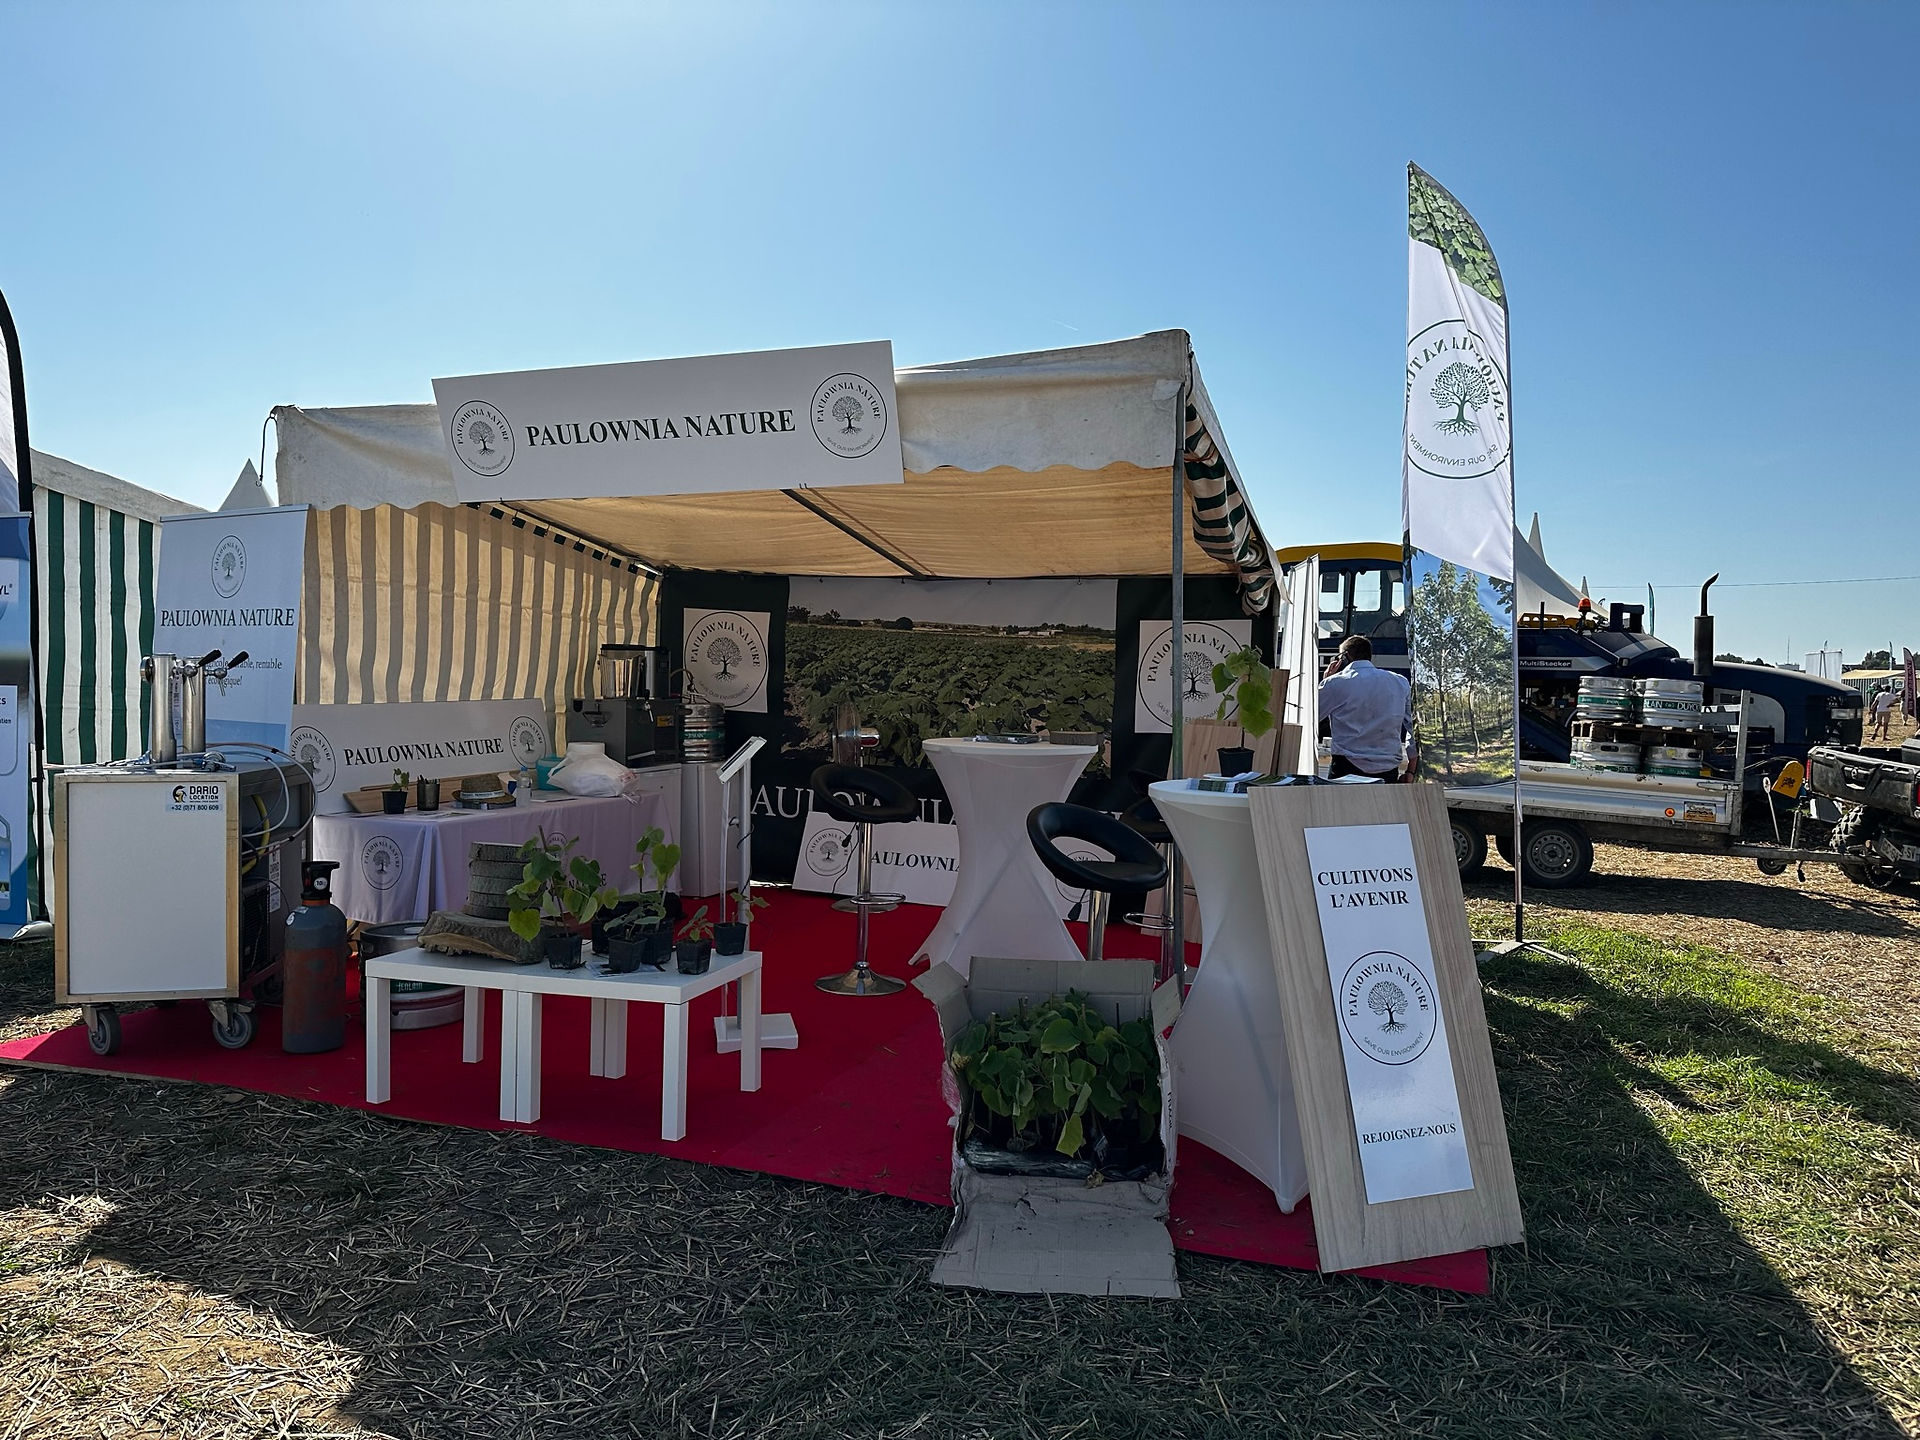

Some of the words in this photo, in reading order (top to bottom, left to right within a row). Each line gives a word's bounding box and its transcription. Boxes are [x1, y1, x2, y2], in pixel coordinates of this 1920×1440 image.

[817, 382, 854, 422] PAULOWNIA
[856, 385, 880, 419] NATURE
[457, 409, 484, 444] PAULOWNIA
[486, 411, 509, 441] NATURE
[526, 416, 680, 447] PAULOWNIA
[684, 409, 796, 438] NATURE
[161, 608, 237, 627] PAULOWNIA
[239, 608, 295, 626] NATURE
[691, 621, 735, 663] PAULOWNIA
[736, 625, 761, 668] NATURE
[1147, 633, 1206, 682] PAULONIA
[291, 733, 312, 760] AULOWNIA
[344, 742, 443, 766] PAULOWNIA
[446, 738, 504, 756] NATURE
[190, 785, 219, 795] DARIO
[871, 850, 960, 873] AULOWNI
[1317, 867, 1414, 886] CULTIVONS
[1330, 890, 1410, 909] L'AVENIR
[1349, 963, 1393, 1016] PAULOWNIA
[1396, 966, 1429, 1011] NATURE
[1363, 1036, 1377, 1050] SAVE
[1377, 1047, 1391, 1056] OUR
[1391, 1031, 1424, 1057] ENVIRONMENT
[1362, 1123, 1457, 1144] REJOIGNEZ-NOUS
